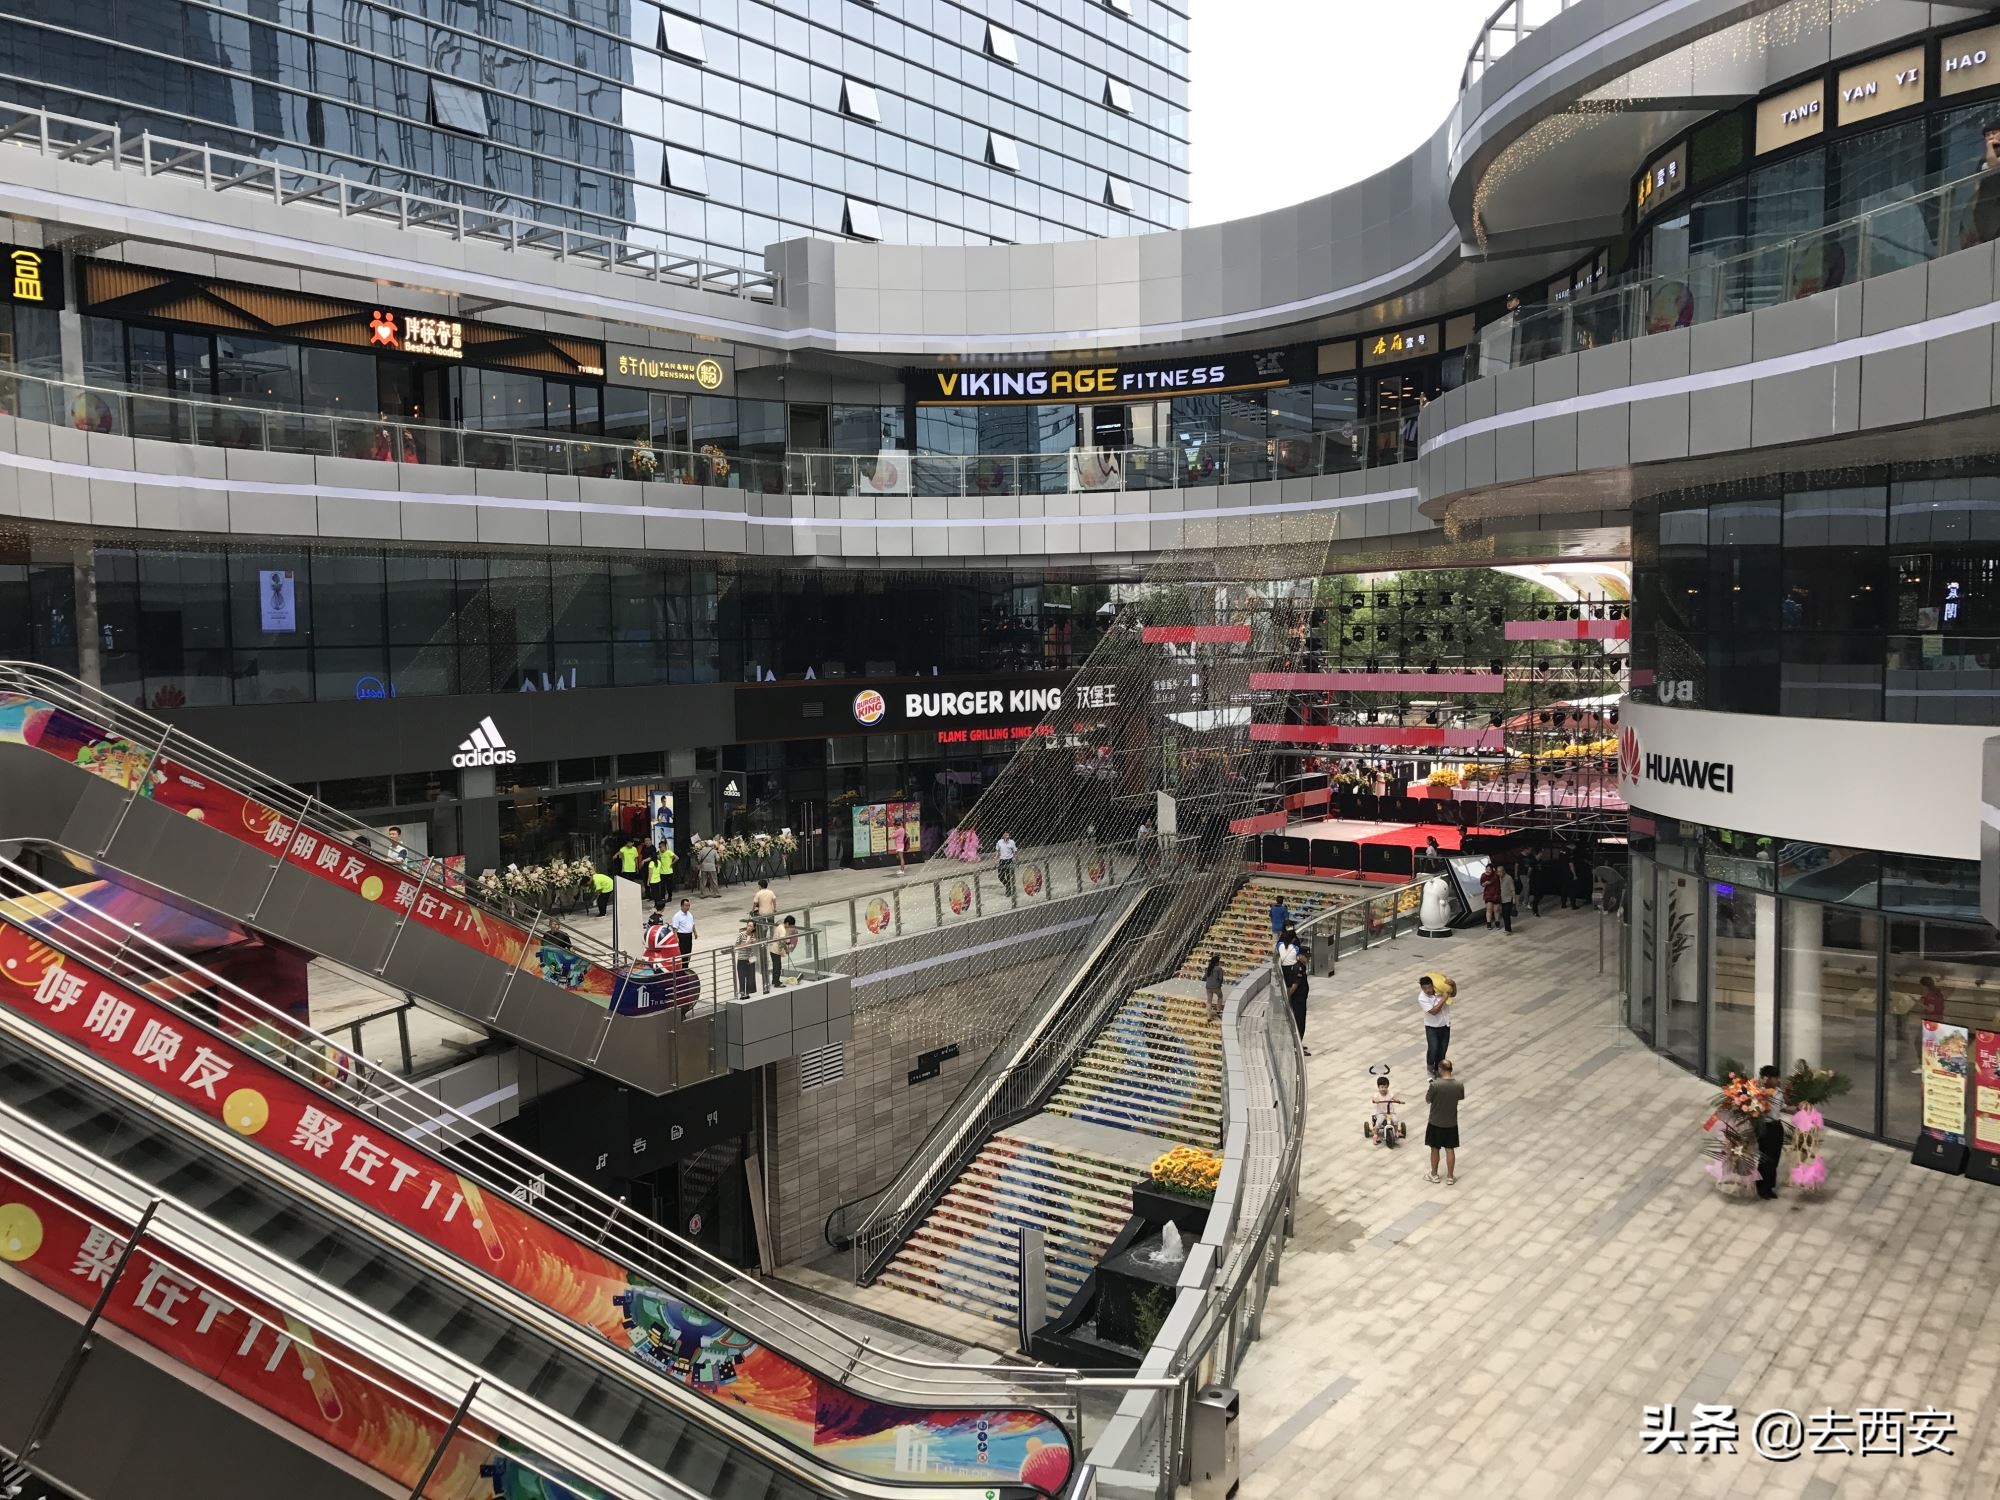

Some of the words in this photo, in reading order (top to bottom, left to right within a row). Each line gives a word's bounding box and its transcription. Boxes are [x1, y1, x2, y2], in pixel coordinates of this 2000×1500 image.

[1781, 100, 1820, 125] TANG
[1843, 81, 1878, 102] YAN
[1895, 68, 1918, 86] YI
[1945, 50, 1987, 72] HAO
[1123, 365, 1226, 391] FITNESS
[856, 695, 881, 709] BURGER
[906, 691, 1003, 718] BURGER
[1009, 688, 1062, 712] KING
[1077, 684, 1117, 709] 汉堡王
[858, 702, 882, 719] KING
[938, 731, 967, 743] FLAME
[970, 728, 1008, 741] GRILLING
[1010, 726, 1033, 738] SINCE
[452, 748, 517, 768] adidas
[1646, 752, 1733, 793] HUAWEI
[723, 786, 741, 797] adidas
[264, 819, 366, 885] 呼朋唤友
[34, 964, 234, 1100] 呼朋唤友
[289, 1105, 463, 1224] 聚在T11
